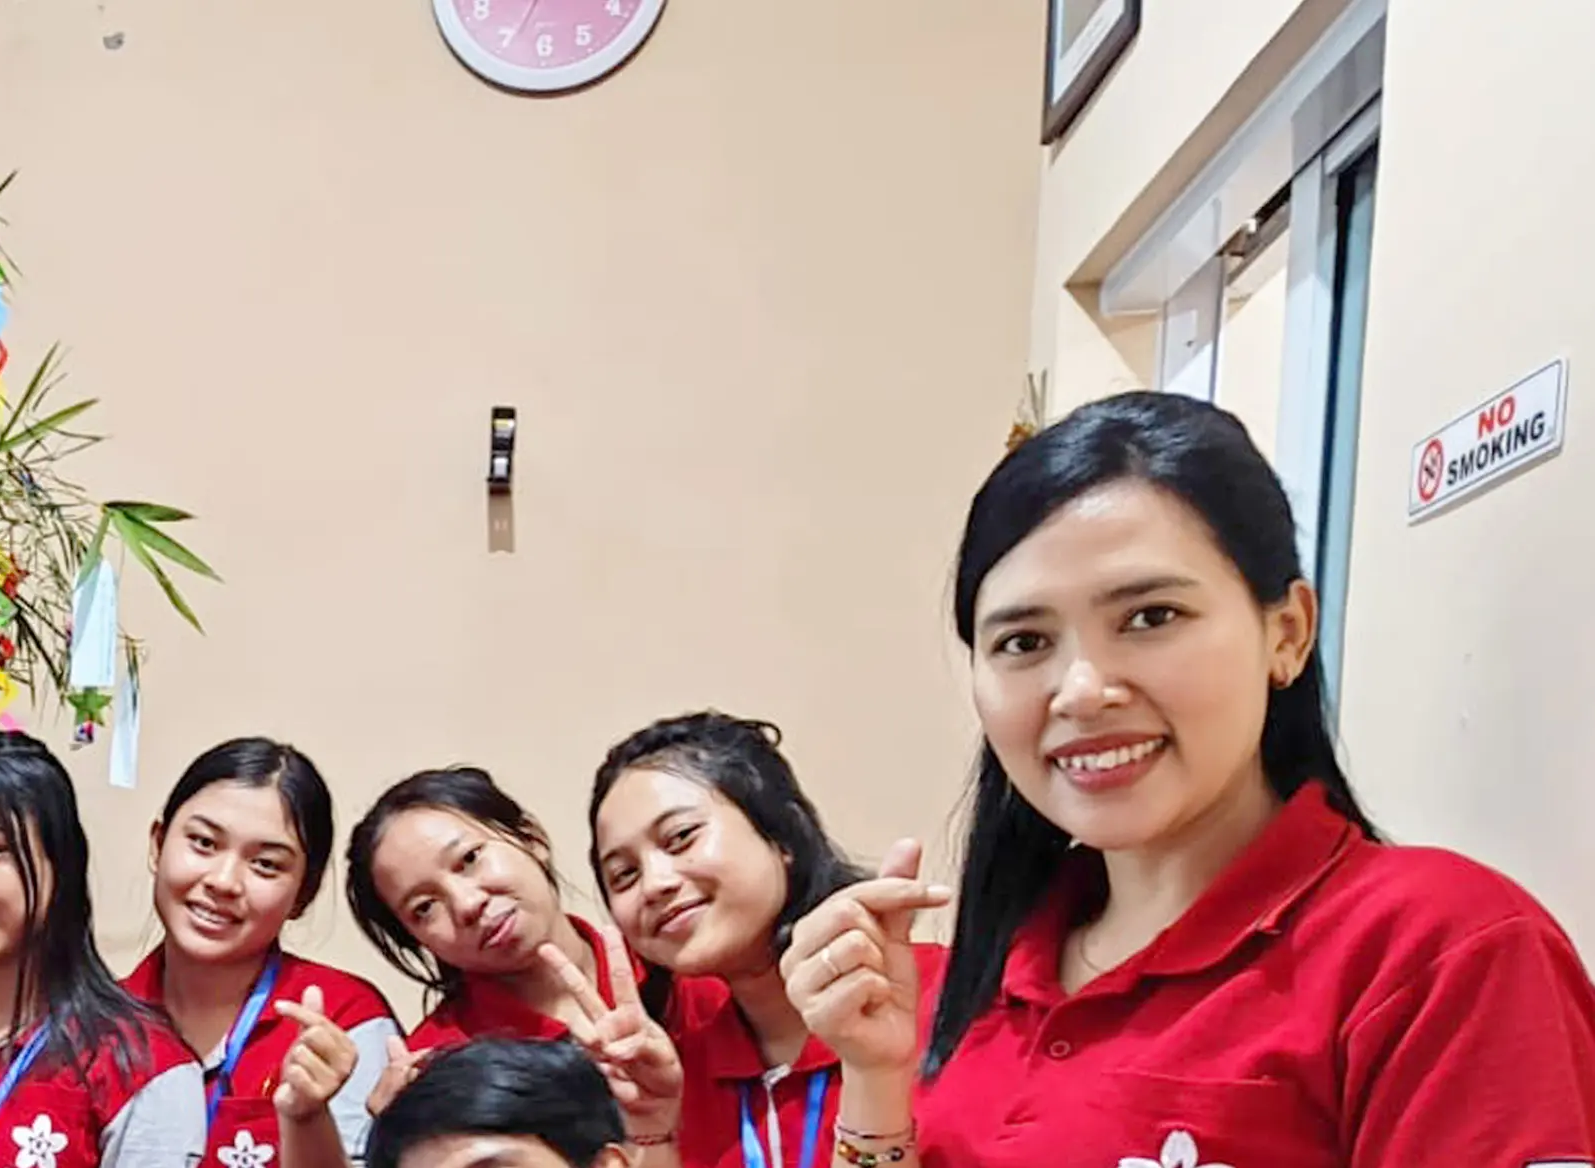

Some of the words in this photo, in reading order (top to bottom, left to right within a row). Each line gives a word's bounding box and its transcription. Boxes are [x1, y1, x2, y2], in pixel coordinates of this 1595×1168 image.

[474, 0, 490, 20] 8
[498, 27, 516, 48] 7
[536, 34, 553, 57] 6
[575, 24, 592, 46] 5
[1477, 395, 1516, 440] NO
[1446, 411, 1545, 486] SMOKING
